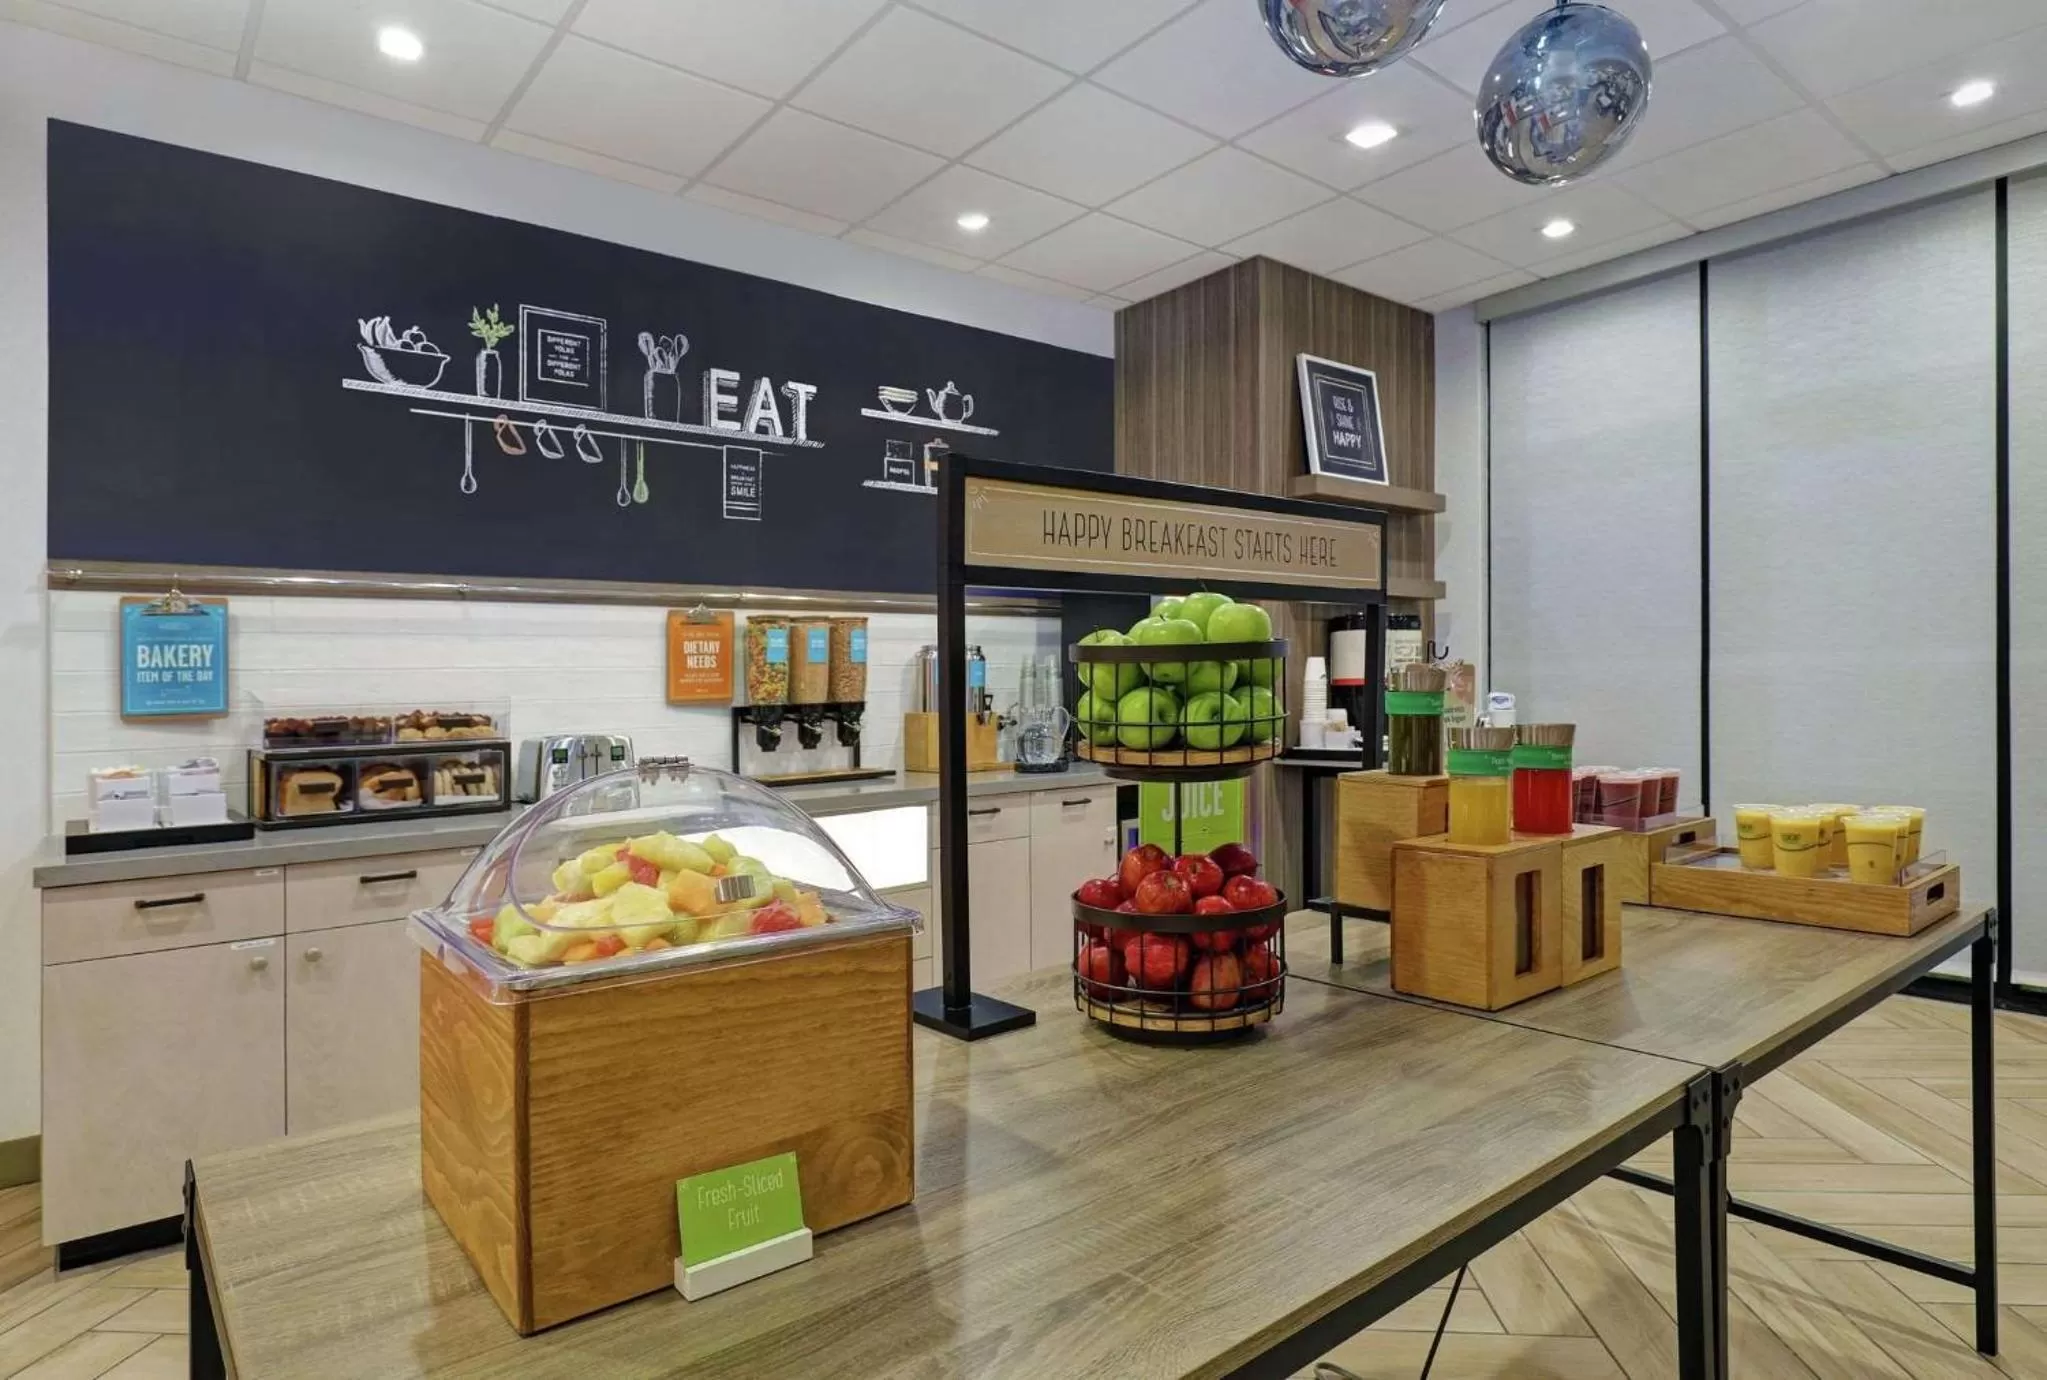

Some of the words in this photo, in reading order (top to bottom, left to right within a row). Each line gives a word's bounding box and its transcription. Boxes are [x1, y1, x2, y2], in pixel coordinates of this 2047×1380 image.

[704, 368, 817, 440] EAT
[1333, 430, 1361, 448] HAPPY
[731, 486, 756, 497] SMILE
[1043, 509, 1112, 549] HAPPY
[1122, 517, 1228, 558] BREAKFAST
[1234, 528, 1292, 563] STARTS
[1299, 536, 1339, 567] HERE
[137, 644, 214, 668] BAKERY
[683, 640, 720, 655] DIETARY
[687, 654, 717, 669] NEEDS
[137, 670, 158, 683] ITEM
[162, 671, 173, 682] OF
[177, 670, 194, 682] THE
[196, 670, 214, 682] DAY
[1161, 782, 1224, 822] JUICE
[698, 1168, 783, 1209] Fresh-Sliced
[728, 1204, 760, 1230] Fruit
